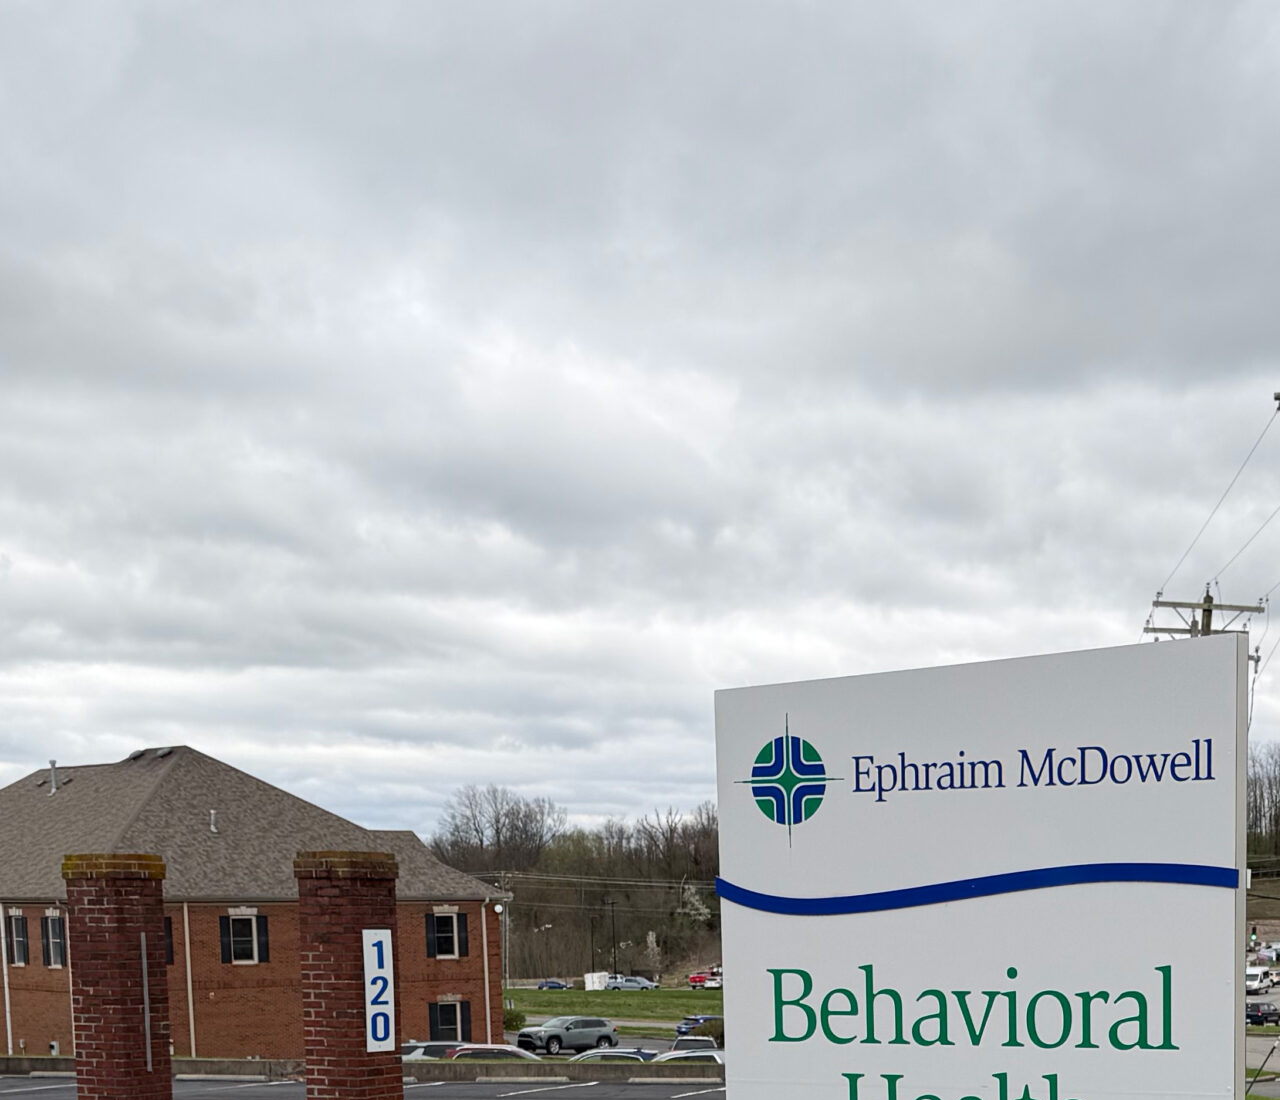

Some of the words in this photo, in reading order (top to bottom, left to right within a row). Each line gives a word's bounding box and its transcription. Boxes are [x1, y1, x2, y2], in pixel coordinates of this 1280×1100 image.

[852, 750, 1005, 802] Ephraim
[1017, 738, 1215, 787] McDowell
[370, 940, 390, 1042] 120
[767, 964, 1180, 1050] Behavioral
